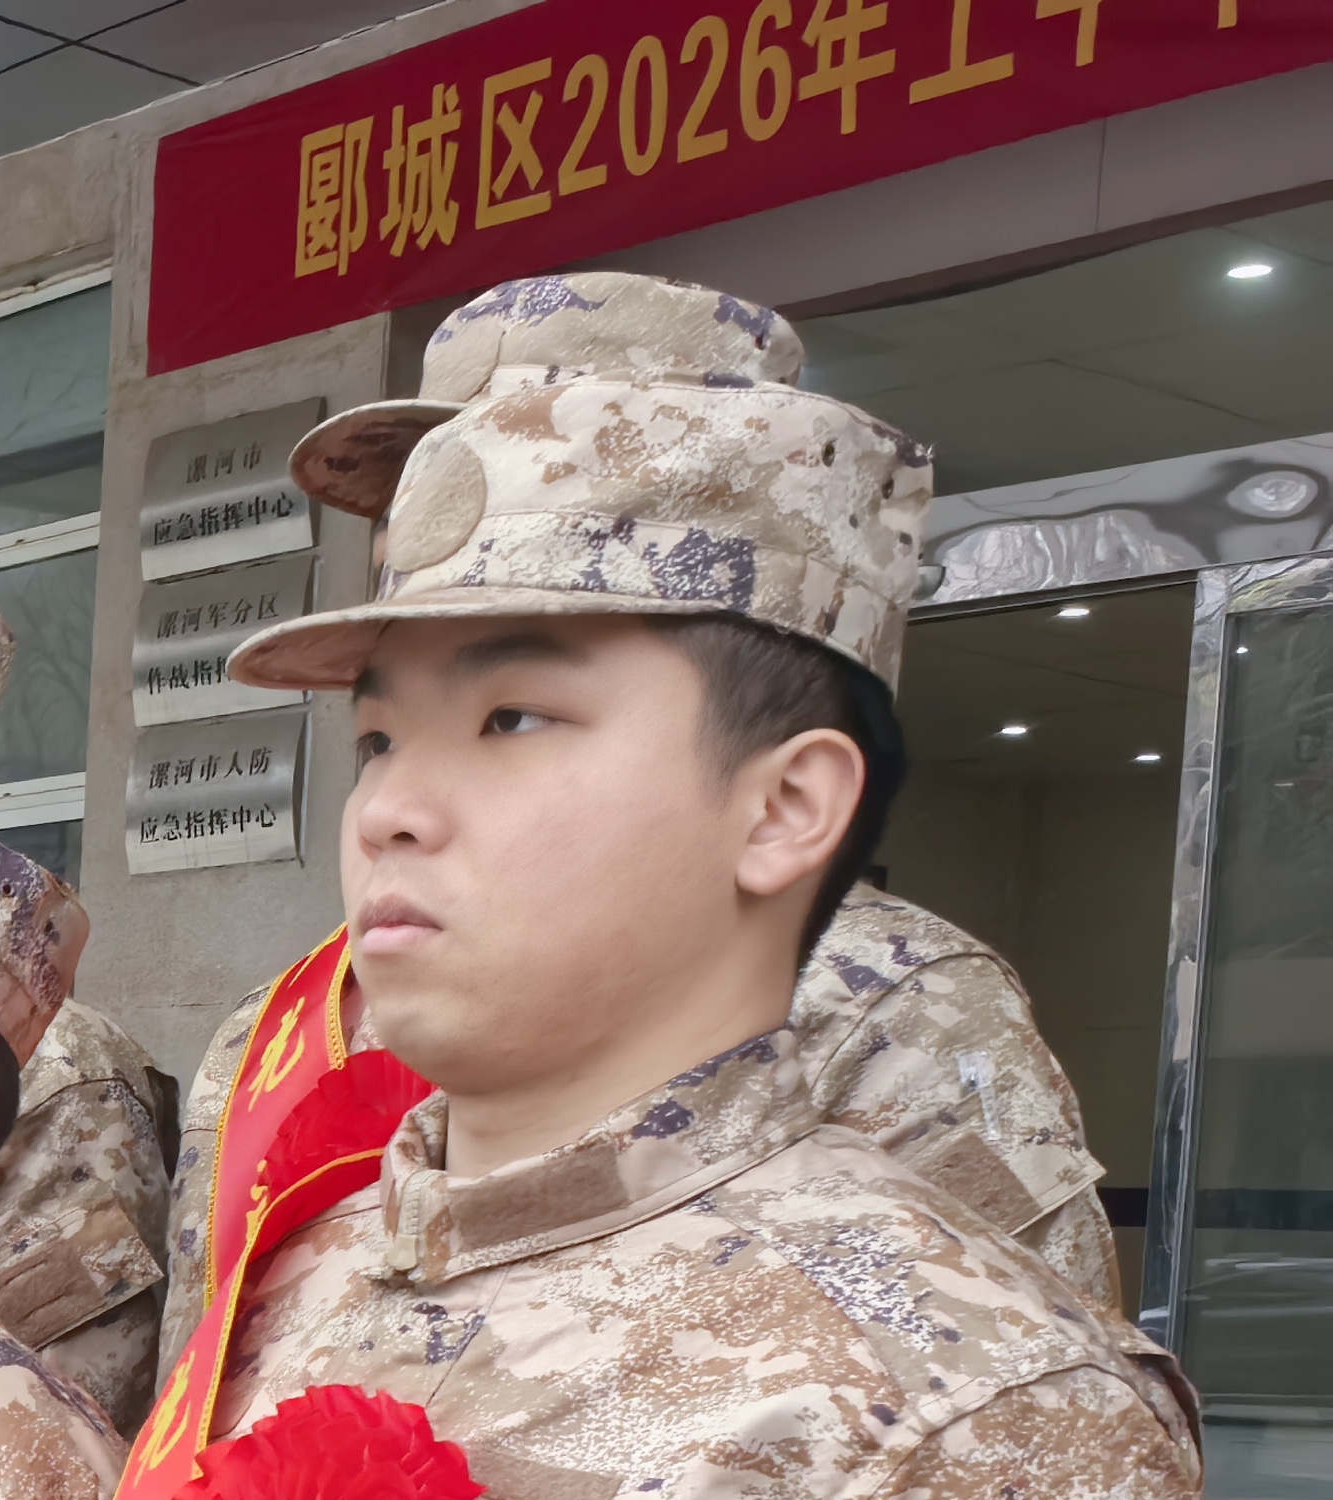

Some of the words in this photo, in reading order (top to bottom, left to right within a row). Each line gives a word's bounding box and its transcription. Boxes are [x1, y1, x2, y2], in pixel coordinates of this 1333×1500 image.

[154, 491, 294, 546] 应急指挥中心
[149, 747, 272, 790] 漯河市人防
[140, 803, 276, 843] 应急指挥中心
